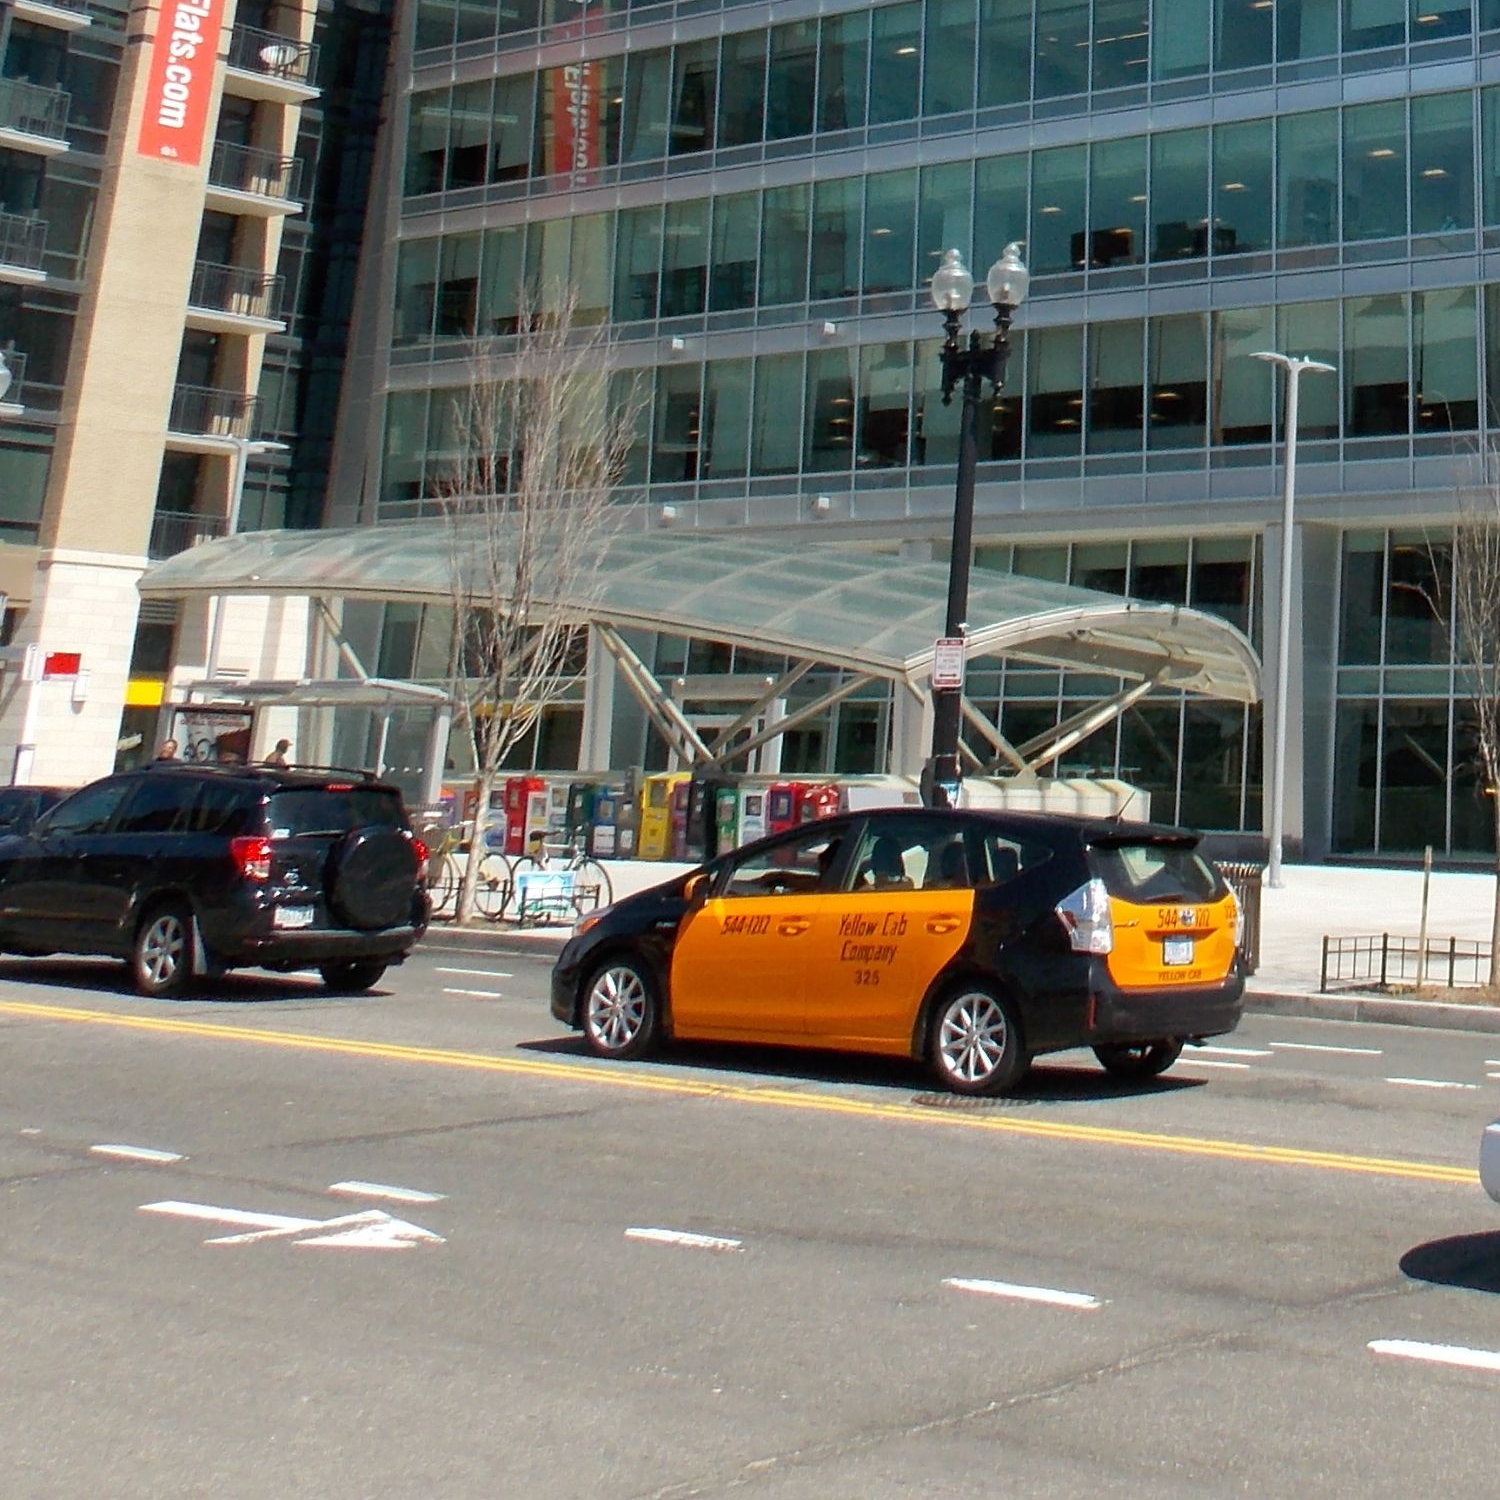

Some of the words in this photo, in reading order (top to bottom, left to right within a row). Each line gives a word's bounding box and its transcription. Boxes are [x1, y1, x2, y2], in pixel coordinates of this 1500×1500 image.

[838, 913, 878, 936] Yellow
[881, 911, 908, 936] Cab
[1157, 907, 1178, 928] 544
[840, 940, 898, 964] Company
[854, 970, 880, 986] 325
